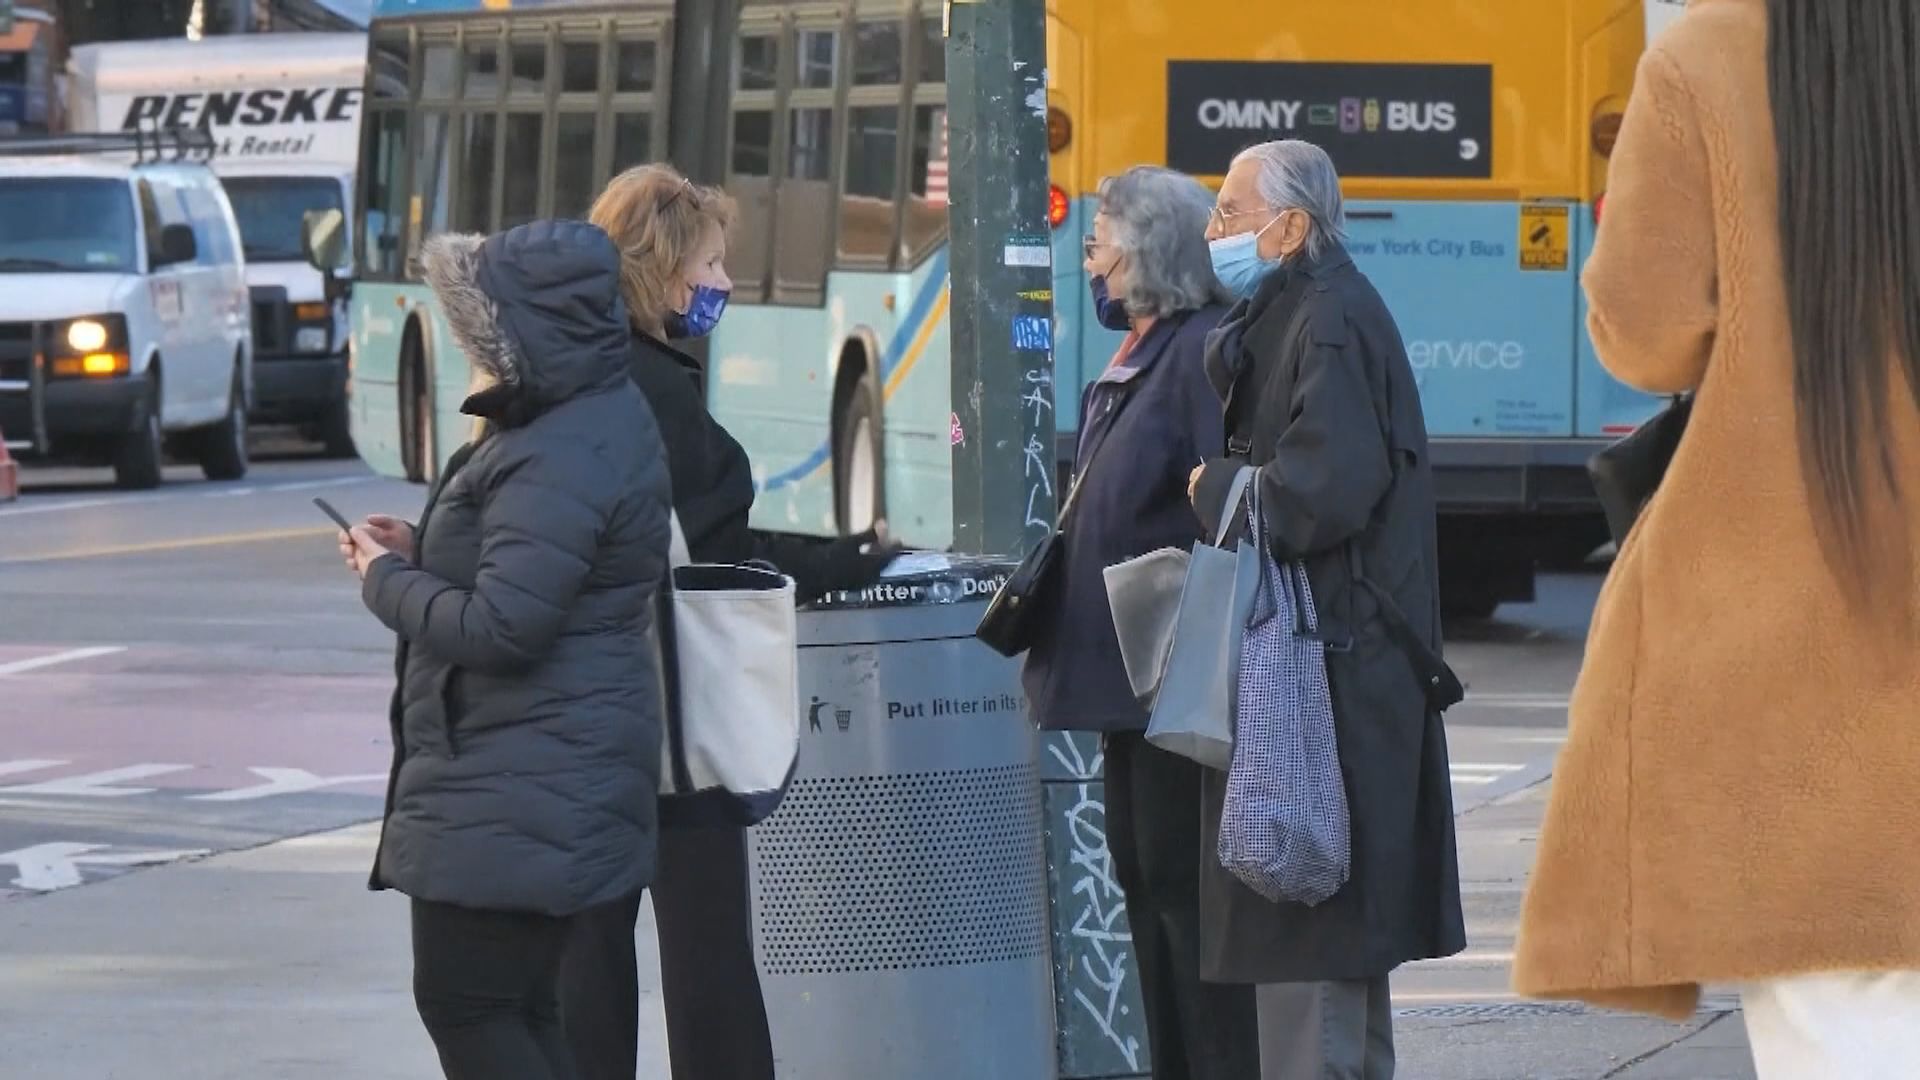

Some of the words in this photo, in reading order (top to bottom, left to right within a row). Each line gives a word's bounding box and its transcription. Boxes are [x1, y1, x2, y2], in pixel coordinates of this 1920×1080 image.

[122, 87, 363, 129] PENSKE
[1198, 99, 1302, 129] OMNY
[1387, 102, 1456, 131] BUS
[239, 134, 314, 156] Rental
[1346, 242, 1375, 255] ew
[1381, 239, 1422, 256] York
[1427, 239, 1464, 260] City
[1470, 240, 1505, 256] Bus
[1408, 340, 1524, 370] ervice
[887, 702, 924, 719] Put
[932, 699, 978, 716] litter
[983, 696, 996, 713] in
[1001, 694, 1016, 710] its
